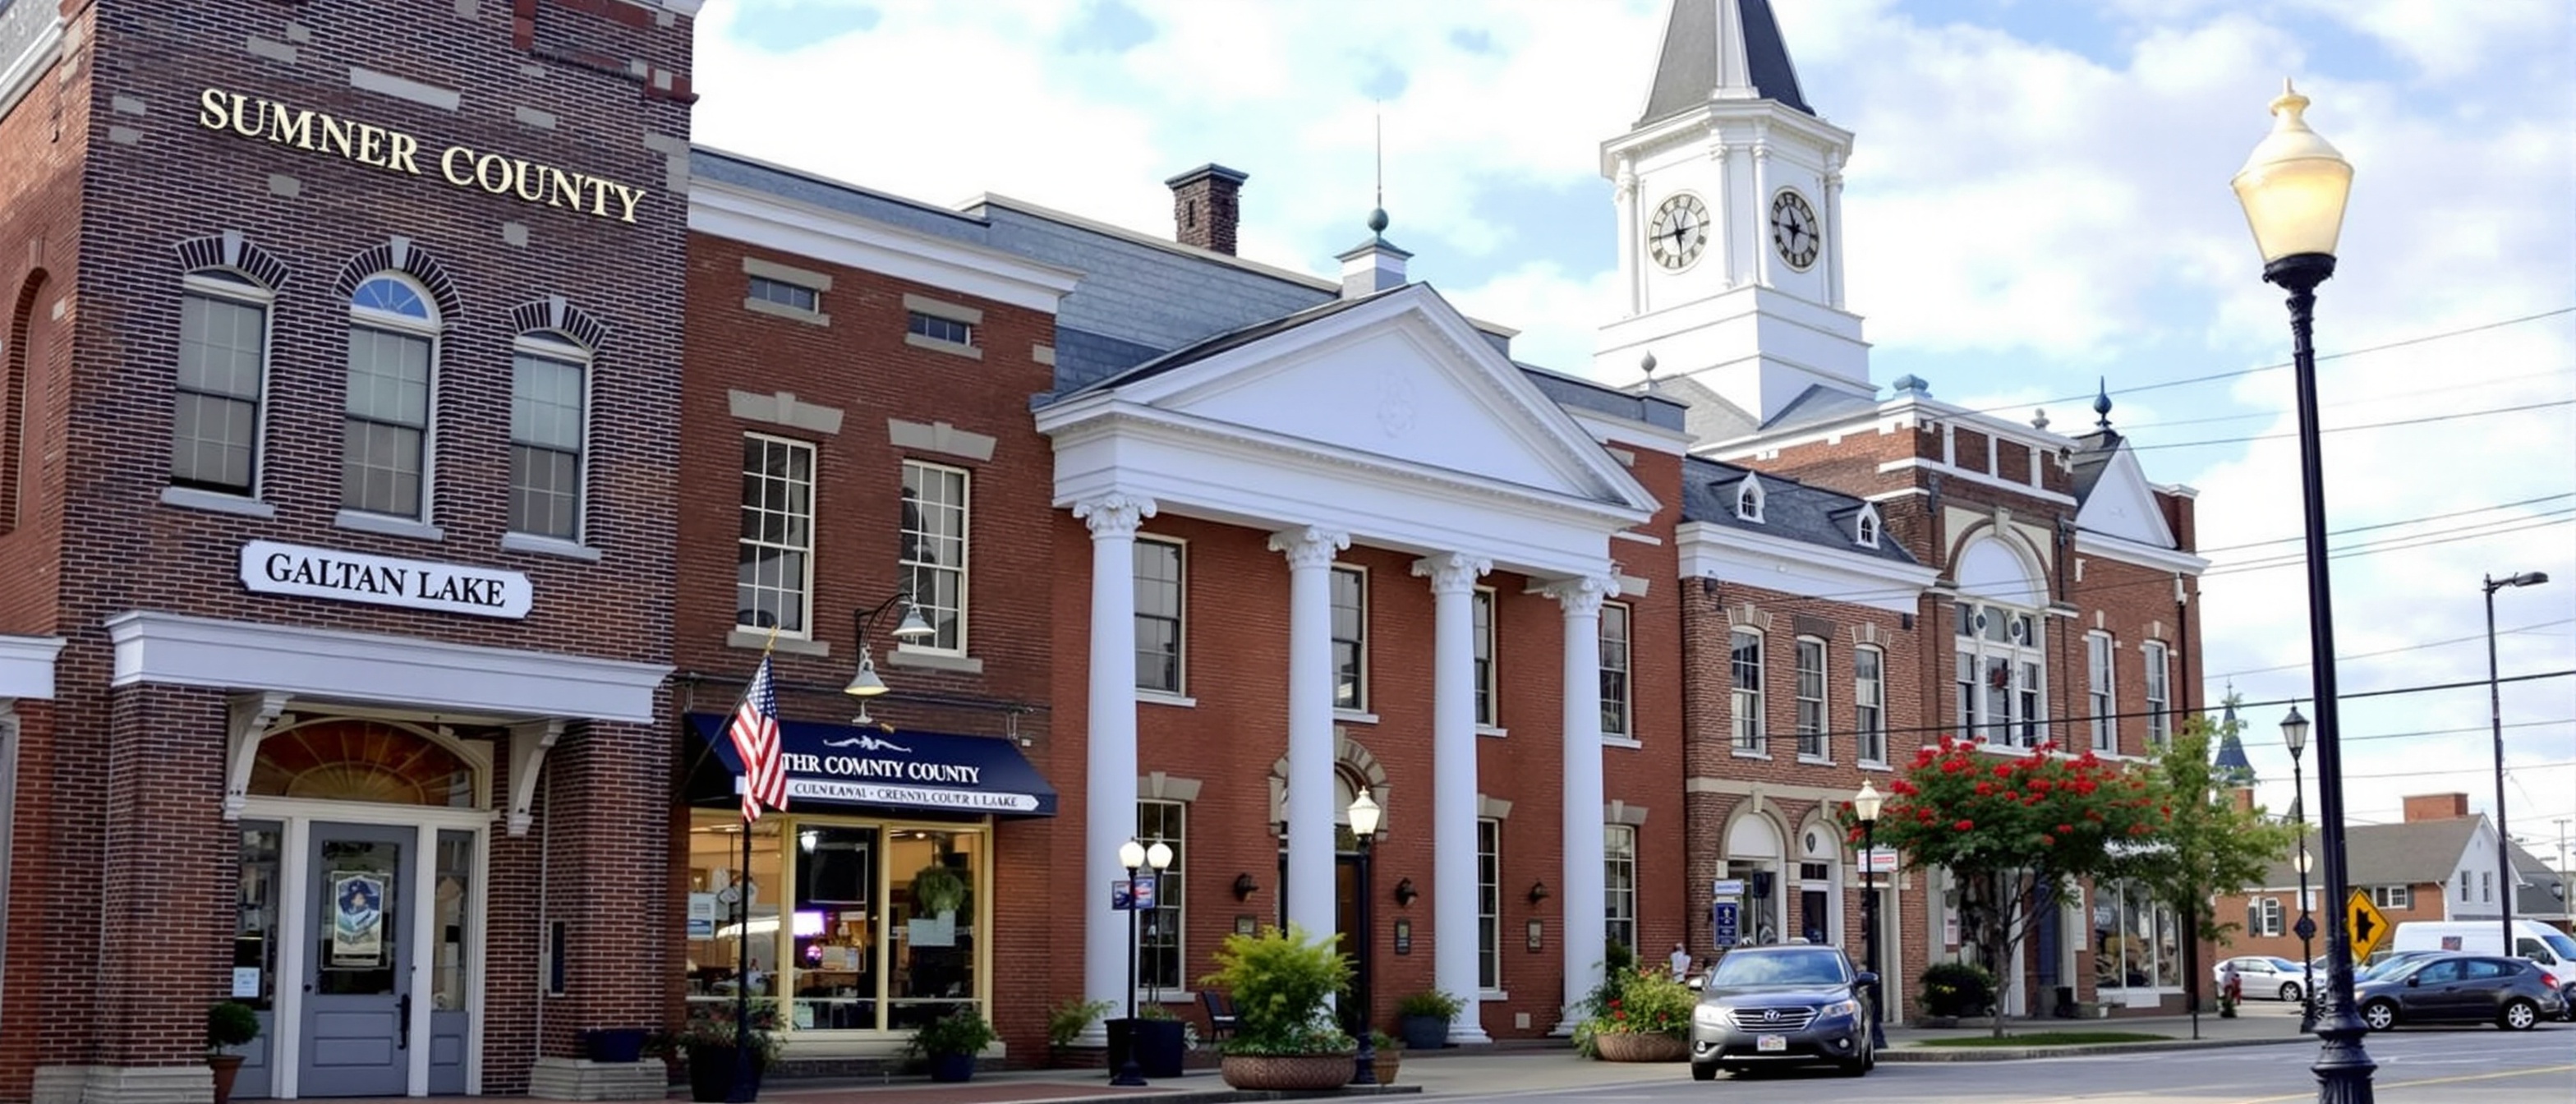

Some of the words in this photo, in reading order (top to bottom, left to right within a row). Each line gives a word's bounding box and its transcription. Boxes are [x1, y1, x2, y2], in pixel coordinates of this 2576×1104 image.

[200, 88, 421, 174] SUMNER
[441, 145, 646, 223] COUNTY
[265, 553, 407, 596] GALTAN
[416, 571, 506, 608] LAKE
[908, 762, 980, 783] COUNTY
